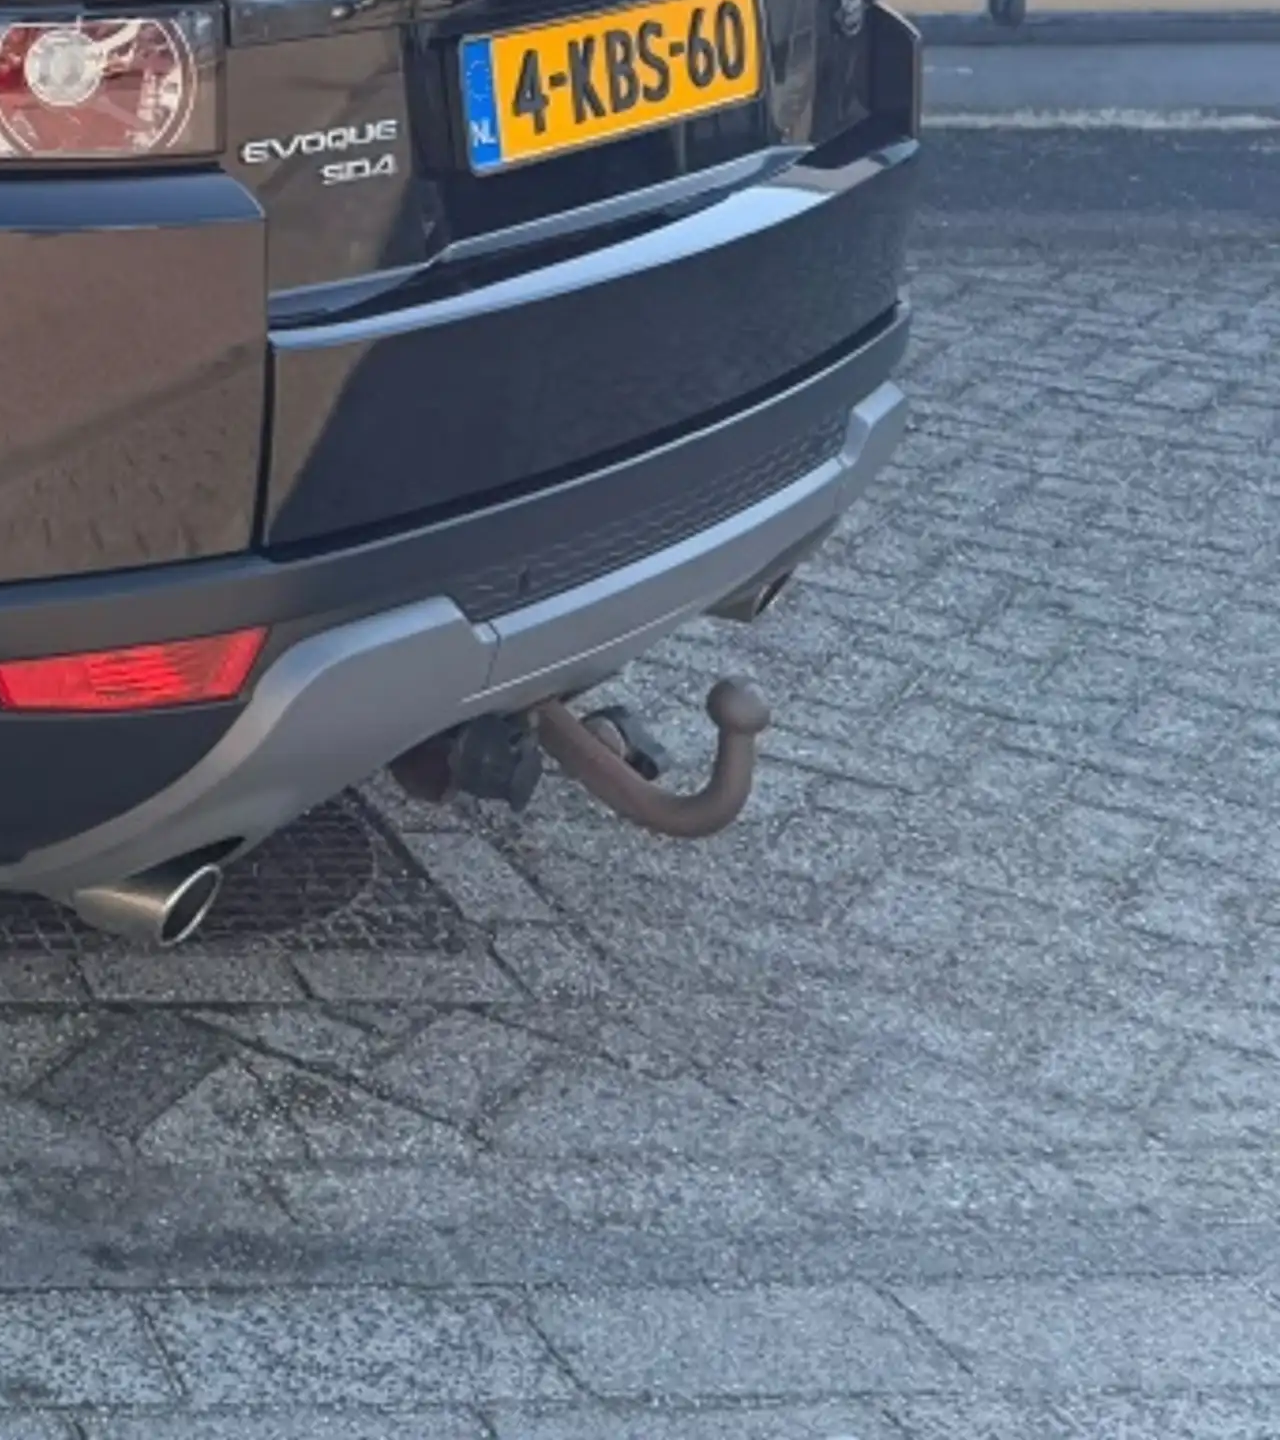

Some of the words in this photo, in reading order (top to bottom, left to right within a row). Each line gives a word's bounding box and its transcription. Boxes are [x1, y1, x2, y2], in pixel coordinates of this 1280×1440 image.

[512, 0, 746, 136] 4-KBS-60
[242, 118, 398, 164] EVOQUE
[469, 119, 496, 147] NL
[321, 153, 397, 186] SD4
